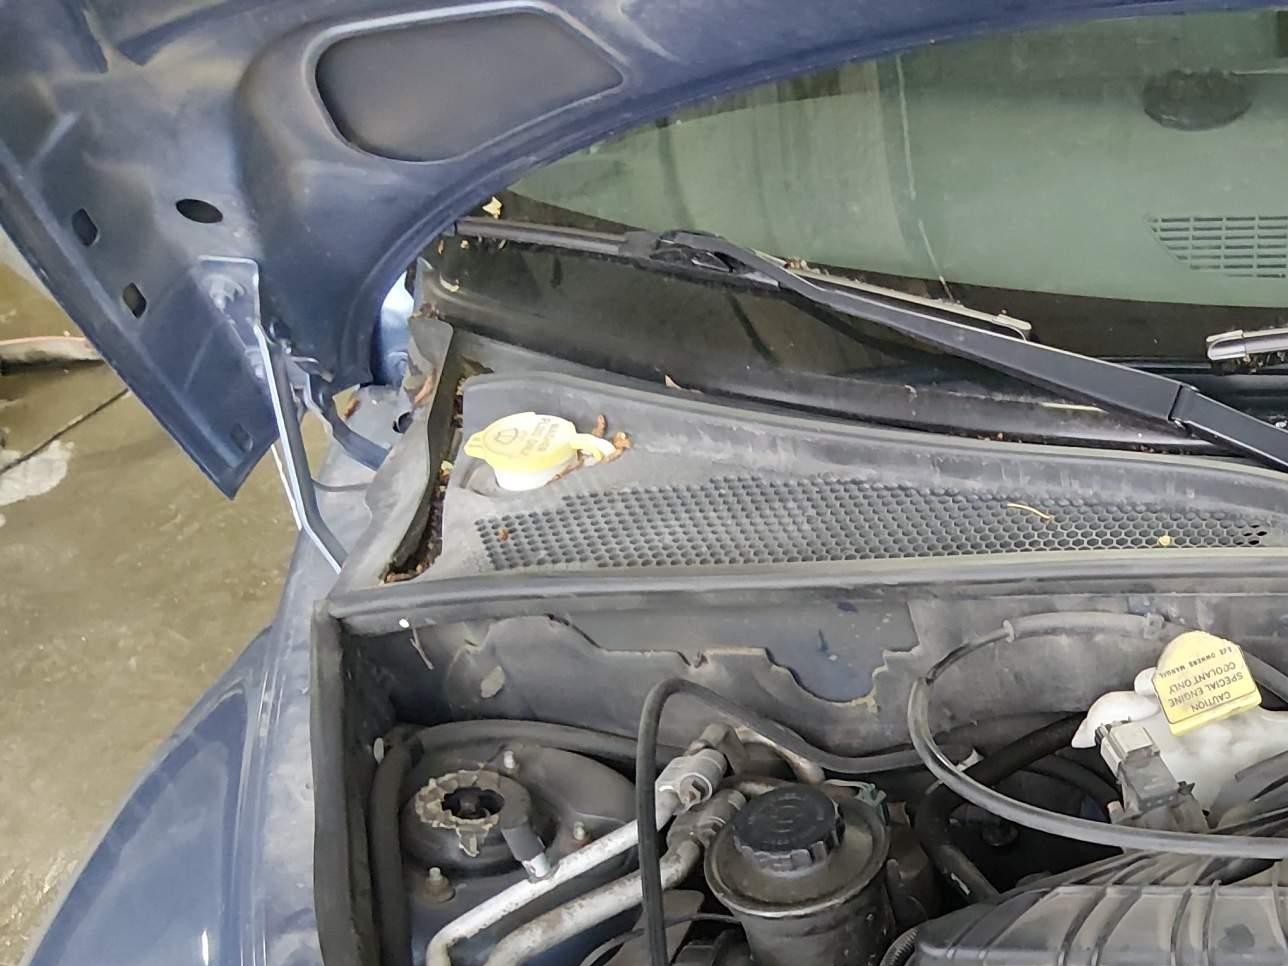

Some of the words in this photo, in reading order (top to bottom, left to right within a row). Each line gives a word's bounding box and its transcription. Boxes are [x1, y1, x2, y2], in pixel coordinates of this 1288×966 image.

[1188, 653, 1216, 667] OWNERS
[1195, 662, 1236, 684] COOLANT
[1205, 672, 1243, 693] SPECIAL
[1169, 678, 1193, 694] ONLY
[1168, 687, 1204, 707] ENGINE
[1191, 691, 1231, 712] CAUTION
